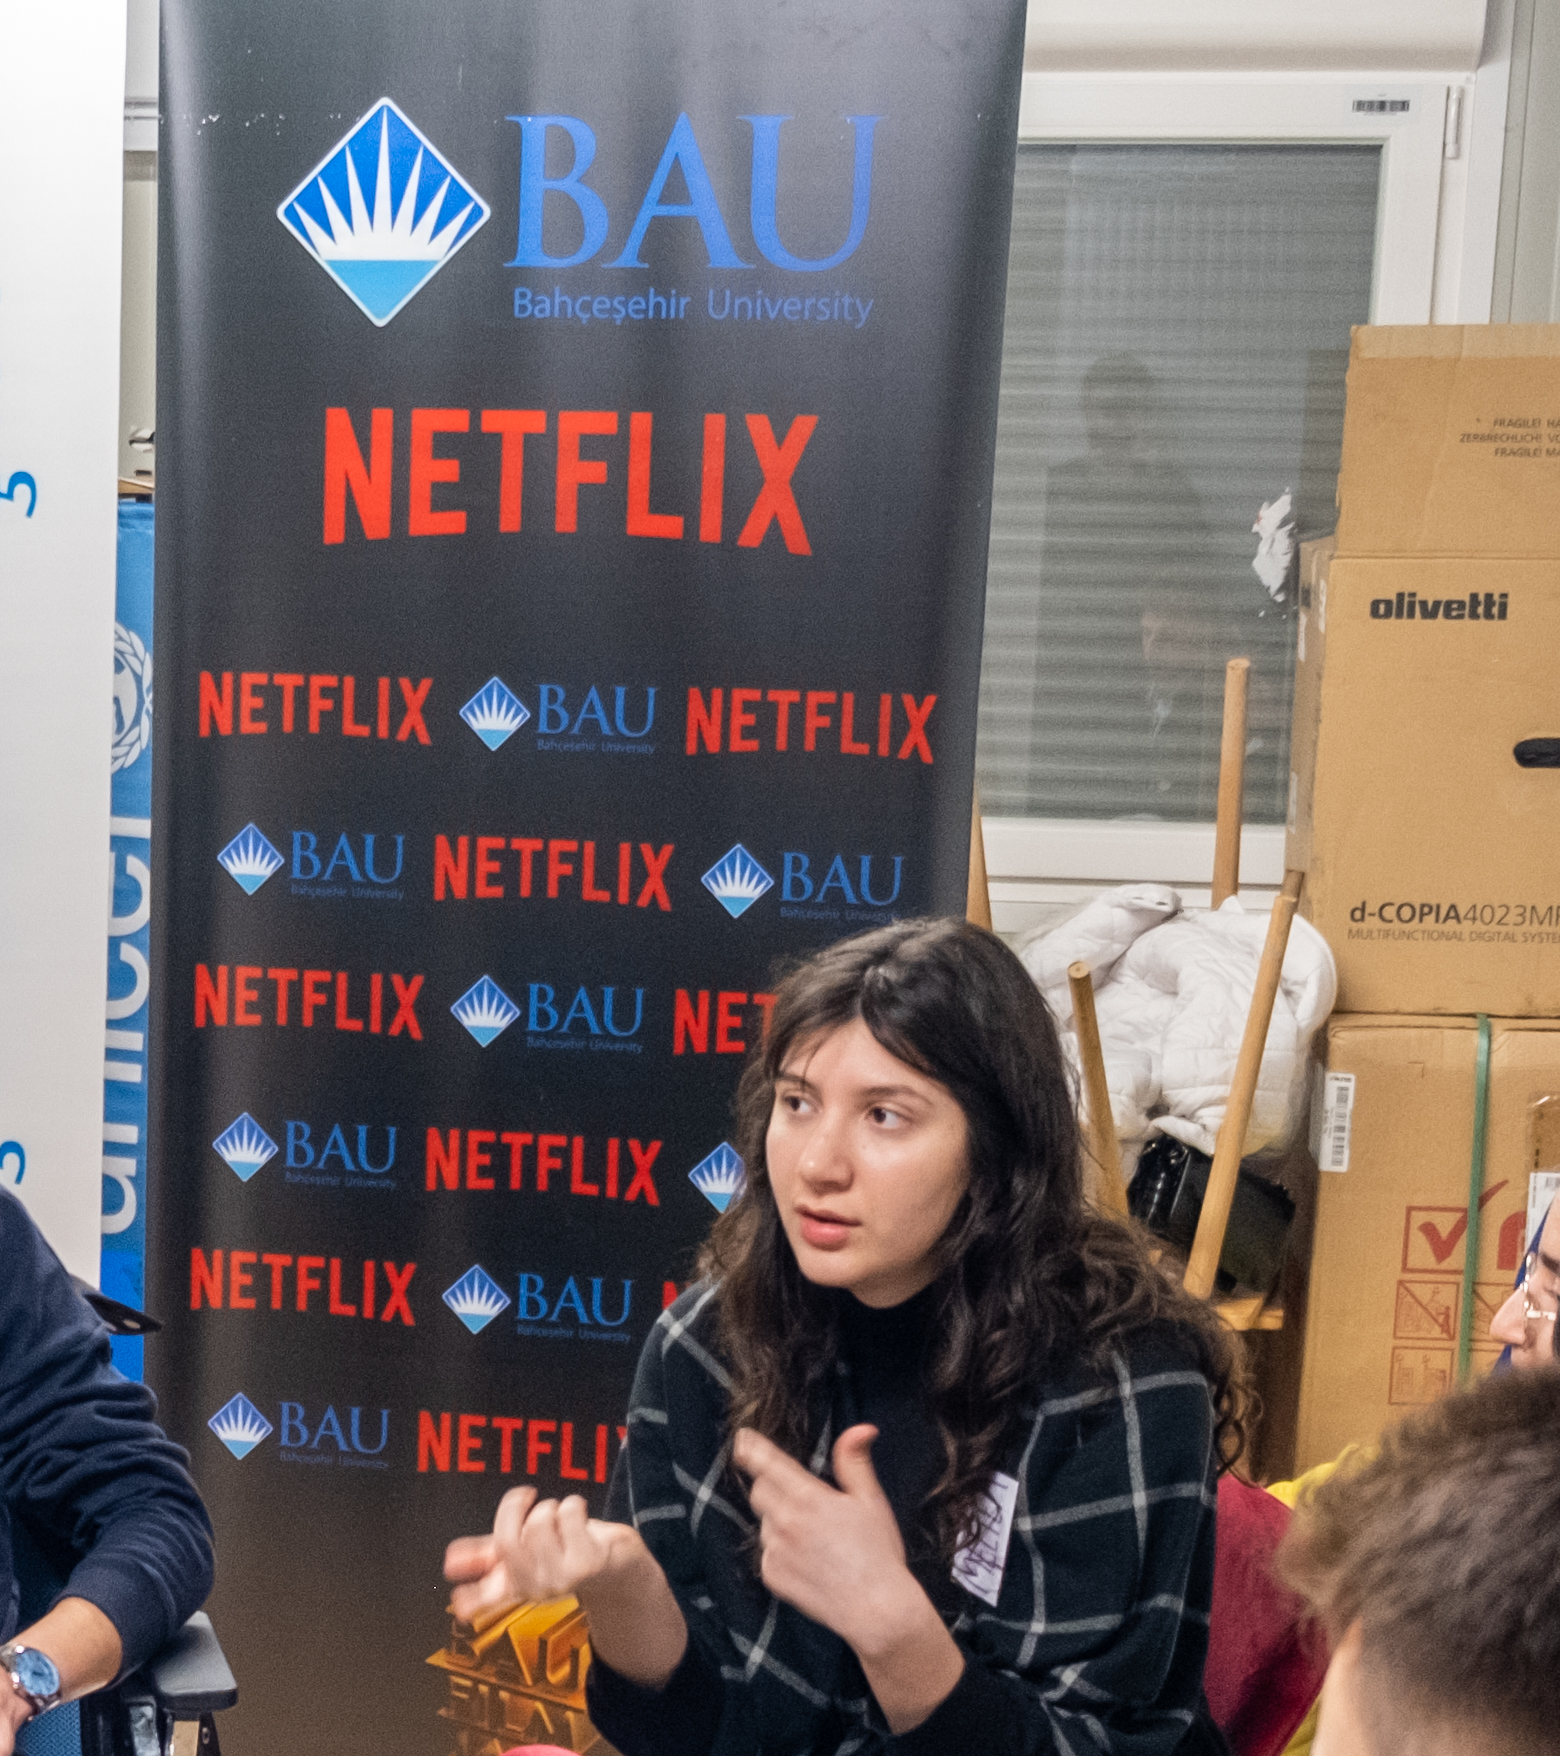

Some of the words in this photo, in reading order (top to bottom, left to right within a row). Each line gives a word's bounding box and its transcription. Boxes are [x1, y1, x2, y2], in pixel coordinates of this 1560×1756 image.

[503, 111, 885, 272] BAU
[513, 285, 691, 326] Bahçeşehir
[706, 287, 874, 330] University
[324, 408, 818, 556] NETFLIX
[1370, 592, 1508, 620] olivetti
[199, 671, 433, 745] NETFLIX
[536, 683, 659, 738] BAU
[686, 687, 937, 764] NETFLIX
[290, 830, 405, 884] BAU
[433, 834, 674, 911] NETFLIX
[780, 851, 904, 906] BAU
[1348, 928, 1463, 942] MULTIFUNCTIONAL
[1469, 931, 1517, 943] DIGITAL
[195, 963, 424, 1040] NETFLIX
[526, 982, 645, 1037] BAU
[283, 1119, 397, 1174] BAU
[425, 1127, 662, 1206] NETFLIX
[190, 1247, 416, 1326] NETFLIX
[516, 1272, 632, 1327] BAU
[278, 1401, 389, 1455] BAU
